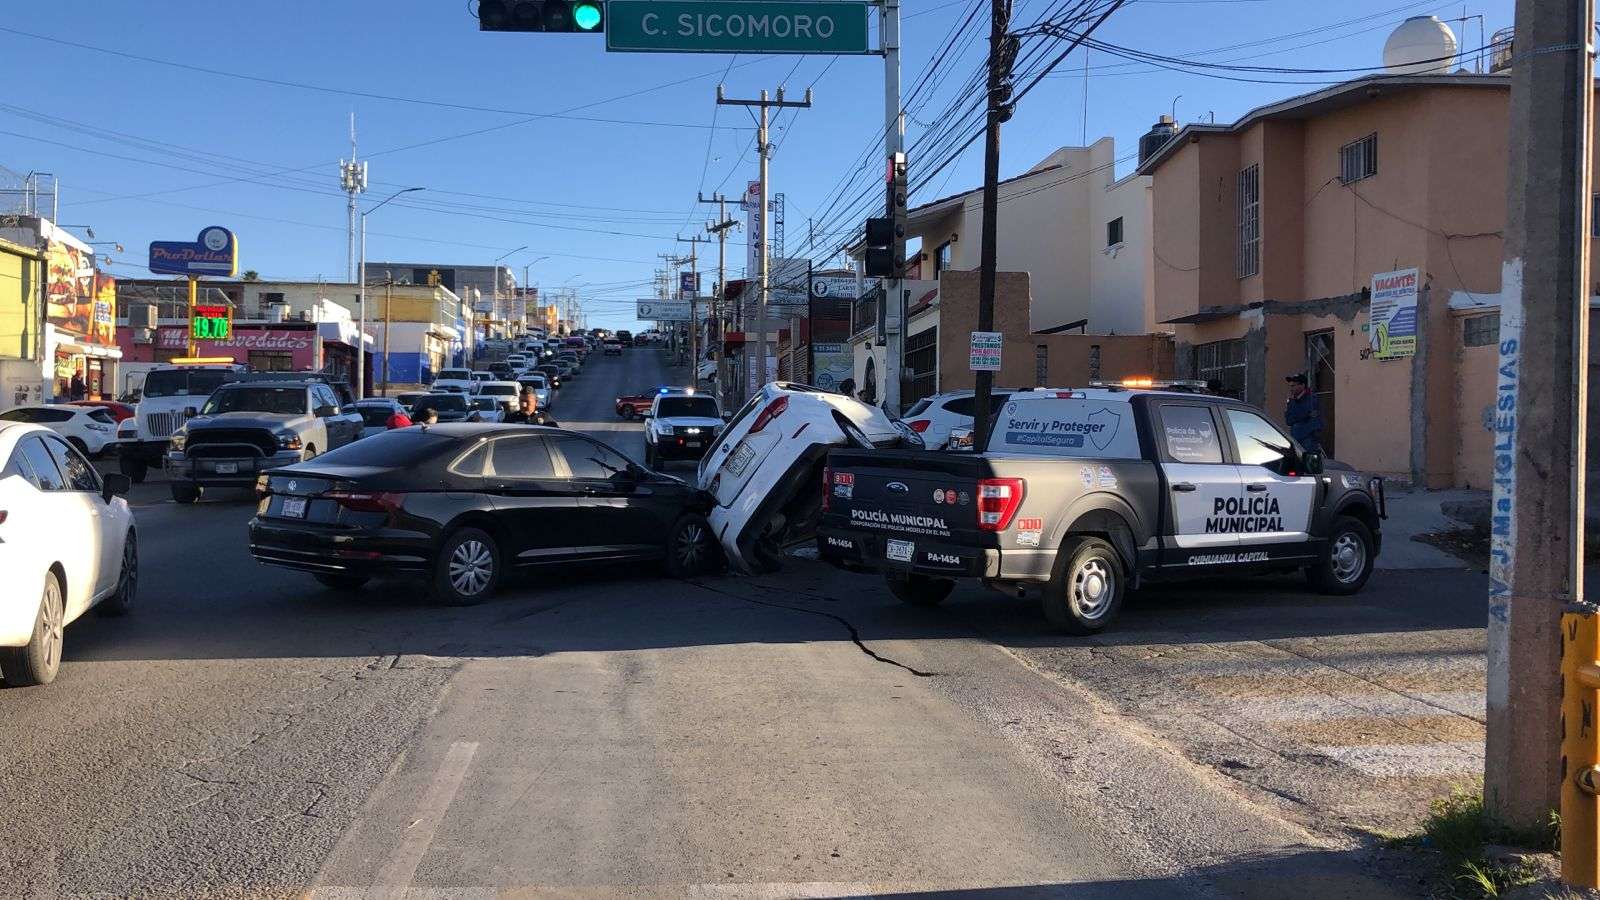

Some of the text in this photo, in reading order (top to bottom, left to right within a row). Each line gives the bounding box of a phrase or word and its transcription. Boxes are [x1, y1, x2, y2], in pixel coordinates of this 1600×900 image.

[641, 12, 835, 38] C. SICOMORO
[194, 317, 228, 337] 19.70
[1008, 418, 1106, 434] Servir y Proteger
[834, 473, 854, 484] 911
[1213, 492, 1281, 516] POLICÍA
[851, 508, 948, 529] POLICÍA MUNICIPAL
[1205, 517, 1285, 533] MUNICIPAL
[828, 537, 853, 549] PA-1454
[927, 552, 961, 565] PA-1454
[1188, 551, 1270, 566] CHIHUAHUA CAPITAL
